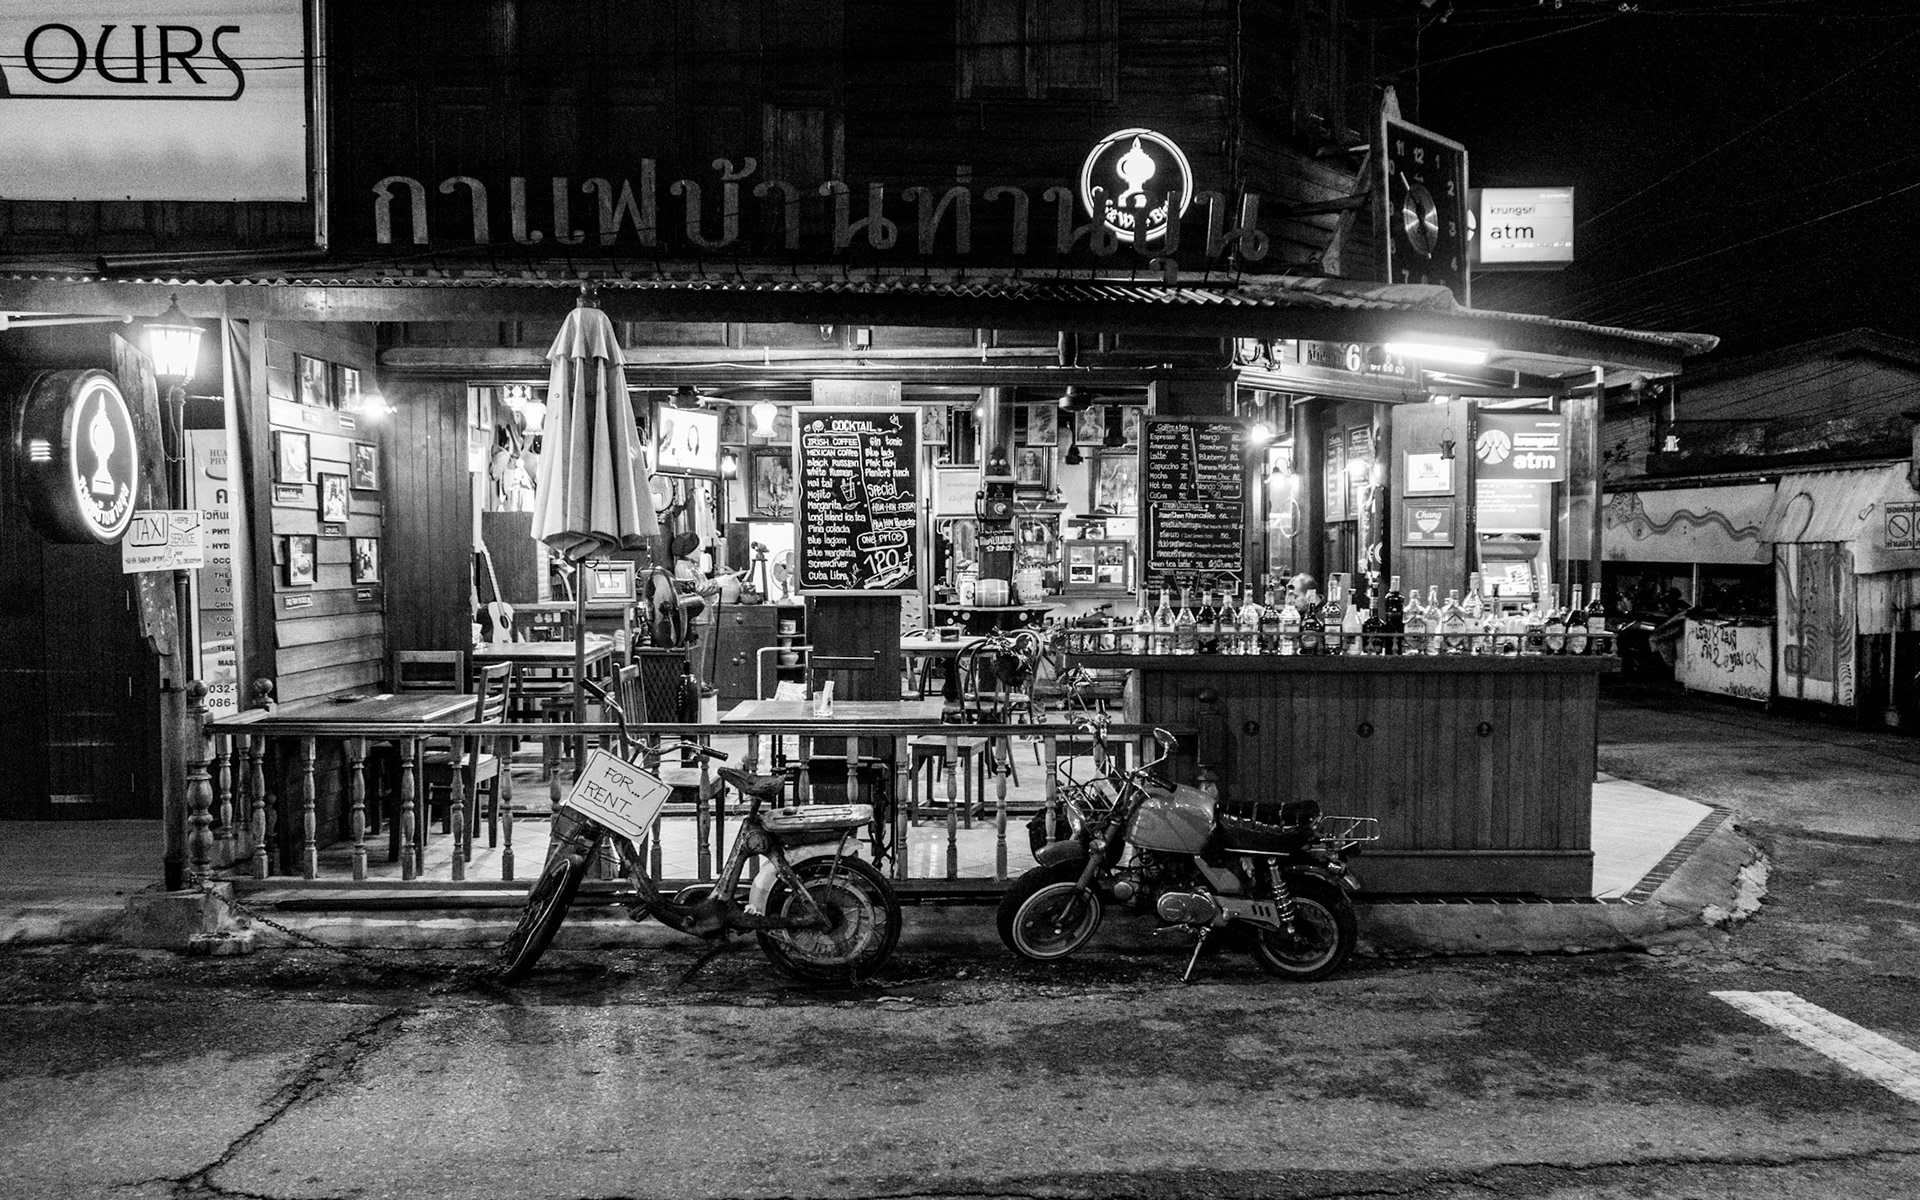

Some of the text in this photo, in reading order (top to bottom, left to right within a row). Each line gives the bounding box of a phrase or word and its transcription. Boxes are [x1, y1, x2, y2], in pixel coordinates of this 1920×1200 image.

[24, 23, 245, 101] OURS
[1413, 147, 1425, 165] 12
[1446, 180, 1456, 197] 2
[1490, 205, 1537, 217] krungsri
[1448, 220, 1457, 237] 3
[1490, 222, 1535, 240] atm
[807, 438, 858, 446] IRISH COFFEE
[869, 435, 903, 447] Gin tonic
[1149, 433, 1176, 443] Espresso
[1199, 434, 1221, 443] Mango
[806, 449, 836, 457] MEXICAN
[865, 446, 880, 457] Blue
[807, 457, 829, 467] Black
[865, 458, 882, 468] Pink
[1513, 452, 1556, 469] atm
[806, 467, 827, 477] White
[1149, 471, 1169, 480] Mocha
[807, 477, 834, 489] Mai tai
[807, 488, 832, 501] Mojito
[807, 499, 843, 513] Margarita
[807, 512, 824, 526] Long
[844, 512, 855, 522] ice
[855, 511, 867, 522] tea
[1415, 509, 1442, 521] Chang
[132, 517, 165, 541] TAXI
[825, 523, 851, 535] colada
[807, 532, 847, 548] Blue lagoon
[807, 545, 857, 560] Blue margarita
[863, 548, 900, 575] 120
[808, 571, 829, 581] Cuba
